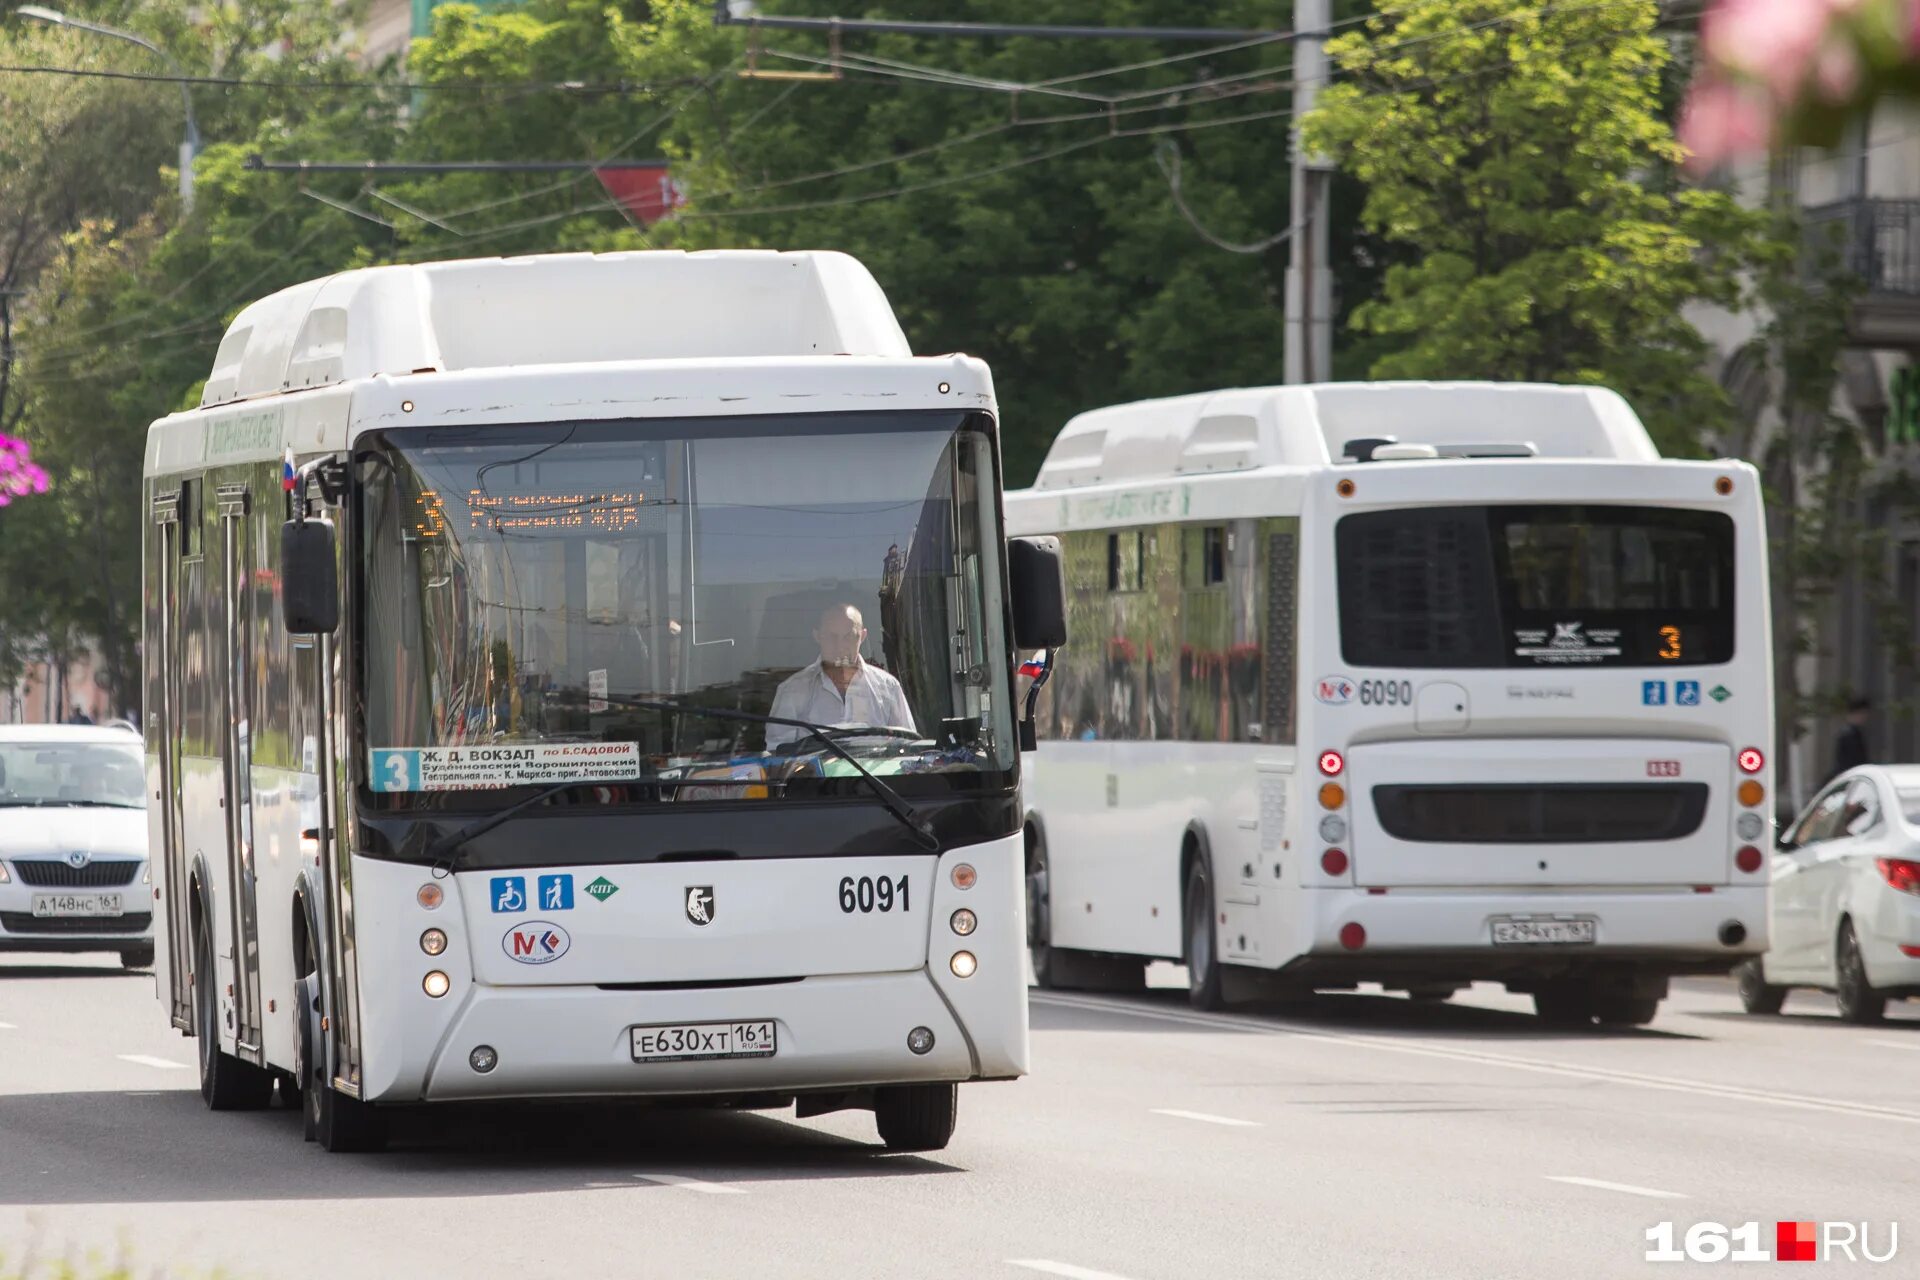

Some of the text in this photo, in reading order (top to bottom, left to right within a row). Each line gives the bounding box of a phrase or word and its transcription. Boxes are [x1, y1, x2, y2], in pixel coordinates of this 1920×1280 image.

[415, 490, 445, 537] 3
[1658, 624, 1683, 660] 3
[1359, 679, 1413, 706] 6090
[422, 751, 442, 763] Ж.
[448, 751, 464, 763] Д.
[469, 749, 535, 761] ВОКЗАЛ
[525, 759, 637, 770] Ворошиловский
[384, 753, 410, 791] 3
[583, 768, 636, 778] Автовокзал
[588, 884, 614, 895] КПГ
[838, 874, 910, 914] 6091
[39, 895, 118, 912] А148НС 161
[641, 1023, 768, 1054] Е630ХТ 161
[742, 1041, 759, 1049] RUS
